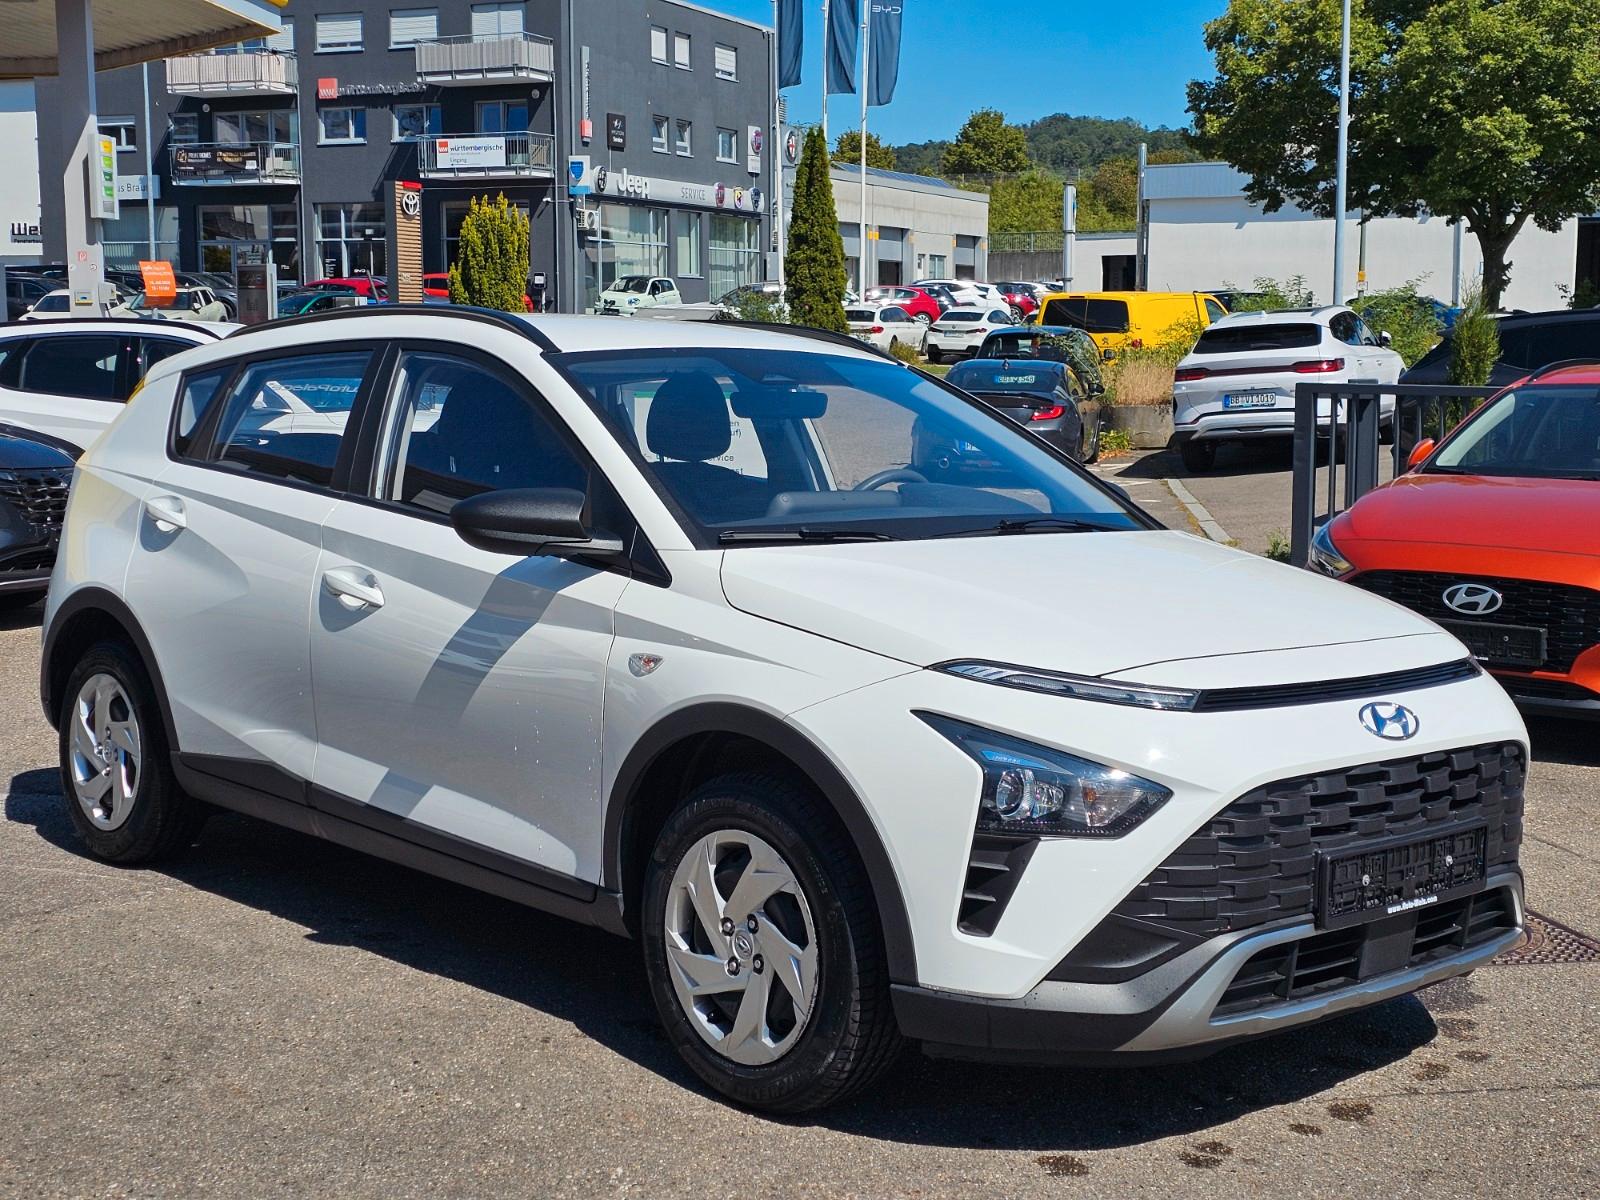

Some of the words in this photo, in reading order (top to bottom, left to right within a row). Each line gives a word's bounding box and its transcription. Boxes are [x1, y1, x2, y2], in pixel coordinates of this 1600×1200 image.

[871, 4, 902, 14] BYD
[617, 167, 649, 199] Jeep
[680, 186, 706, 201] SERVICE
[1231, 395, 1240, 404] BB
